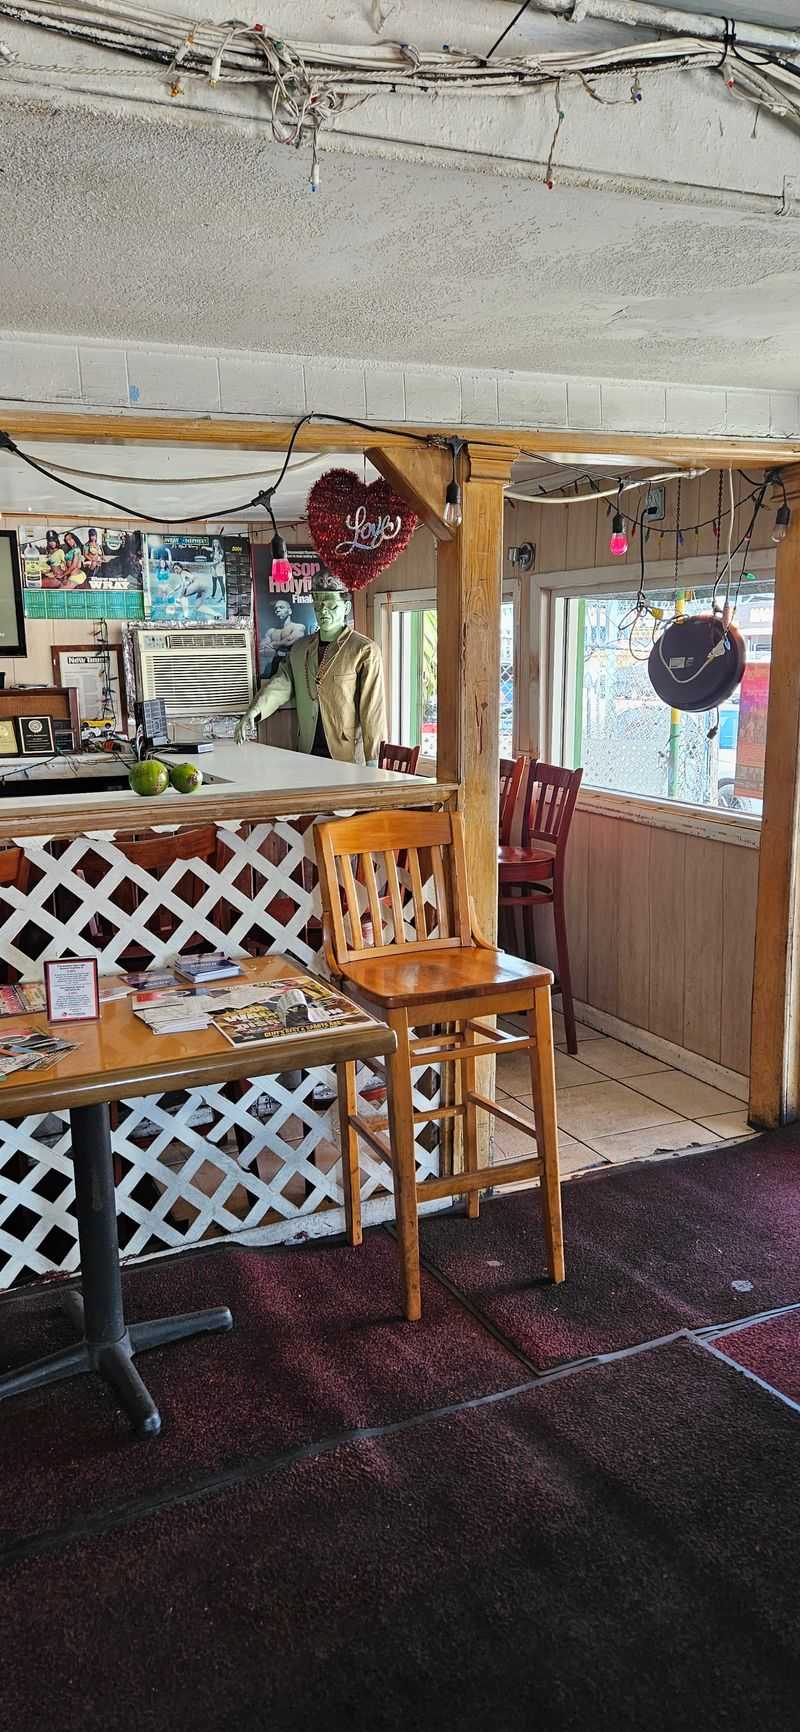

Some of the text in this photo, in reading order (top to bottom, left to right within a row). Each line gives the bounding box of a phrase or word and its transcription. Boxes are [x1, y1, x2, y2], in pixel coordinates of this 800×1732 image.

[335, 506, 401, 556] Love
[290, 563, 321, 577] son
[88, 581, 130, 590] WRAY
[68, 656, 87, 664] New
